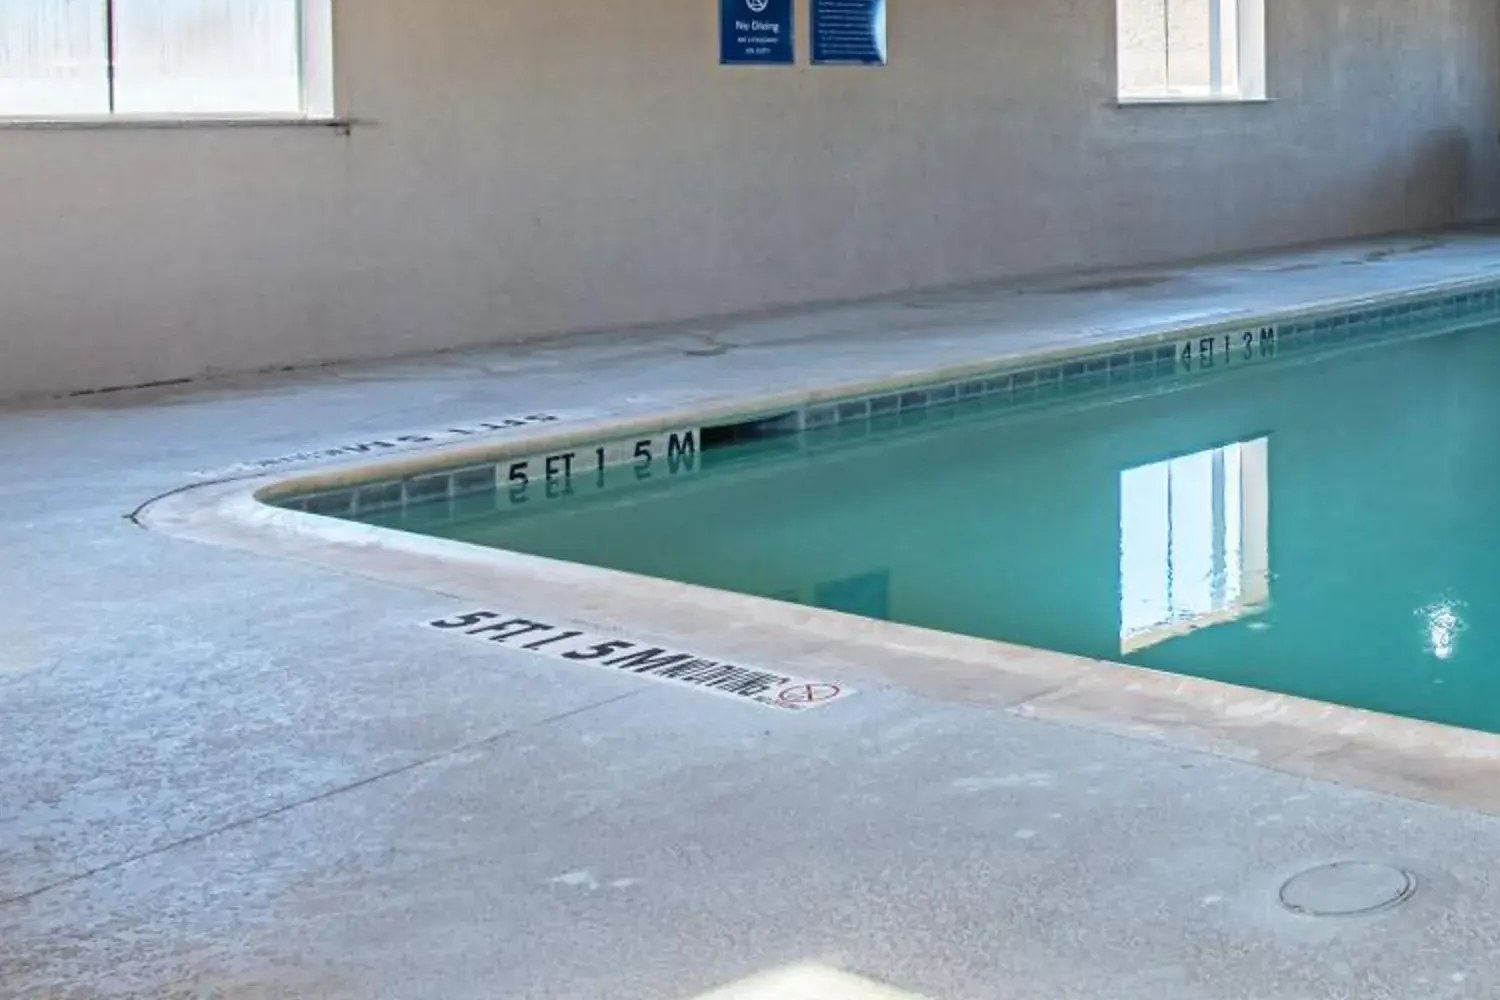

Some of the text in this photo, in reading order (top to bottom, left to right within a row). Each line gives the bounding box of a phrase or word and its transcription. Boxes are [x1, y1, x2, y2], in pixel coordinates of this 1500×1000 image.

[752, 19, 779, 34] Diving
[1200, 337, 1215, 354] FT
[509, 462, 529, 484] 5
[545, 452, 575, 480] FT
[634, 439, 652, 461] 5
[668, 430, 695, 456] M
[430, 611, 499, 628] 5
